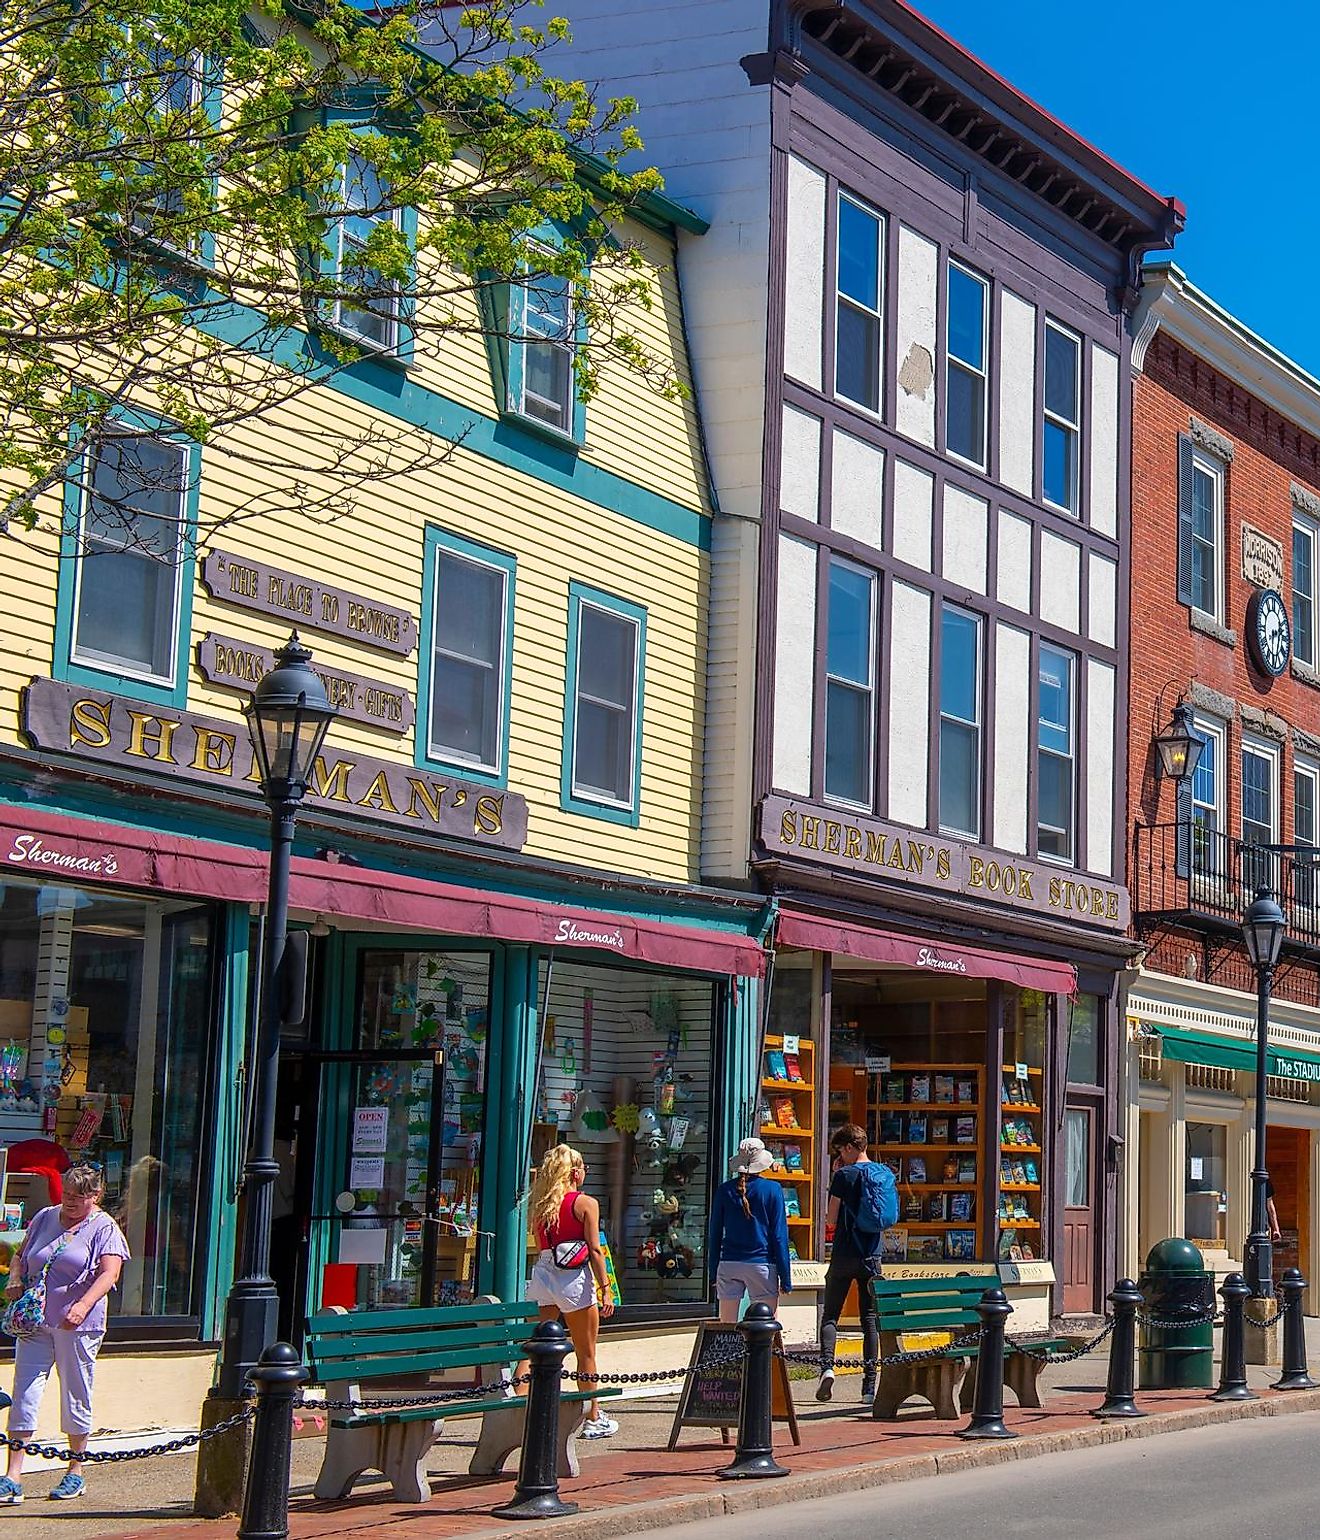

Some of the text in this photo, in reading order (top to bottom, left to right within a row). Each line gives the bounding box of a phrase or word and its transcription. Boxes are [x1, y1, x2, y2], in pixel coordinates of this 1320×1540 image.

[267, 575, 314, 616] PLACE
[321, 593, 340, 623] TO
[364, 686, 403, 722] GIFTS
[69, 698, 504, 836] SHEMAN'S
[8, 835, 119, 875] Sherman's
[780, 810, 1120, 921] SHERMAN'S BOOK STORE
[555, 920, 625, 948] Sherman's
[915, 948, 967, 972] Sherman's
[1276, 1057, 1292, 1076] The
[358, 1113, 384, 1121] OPEN
[902, 1269, 950, 1278] Bookstore
